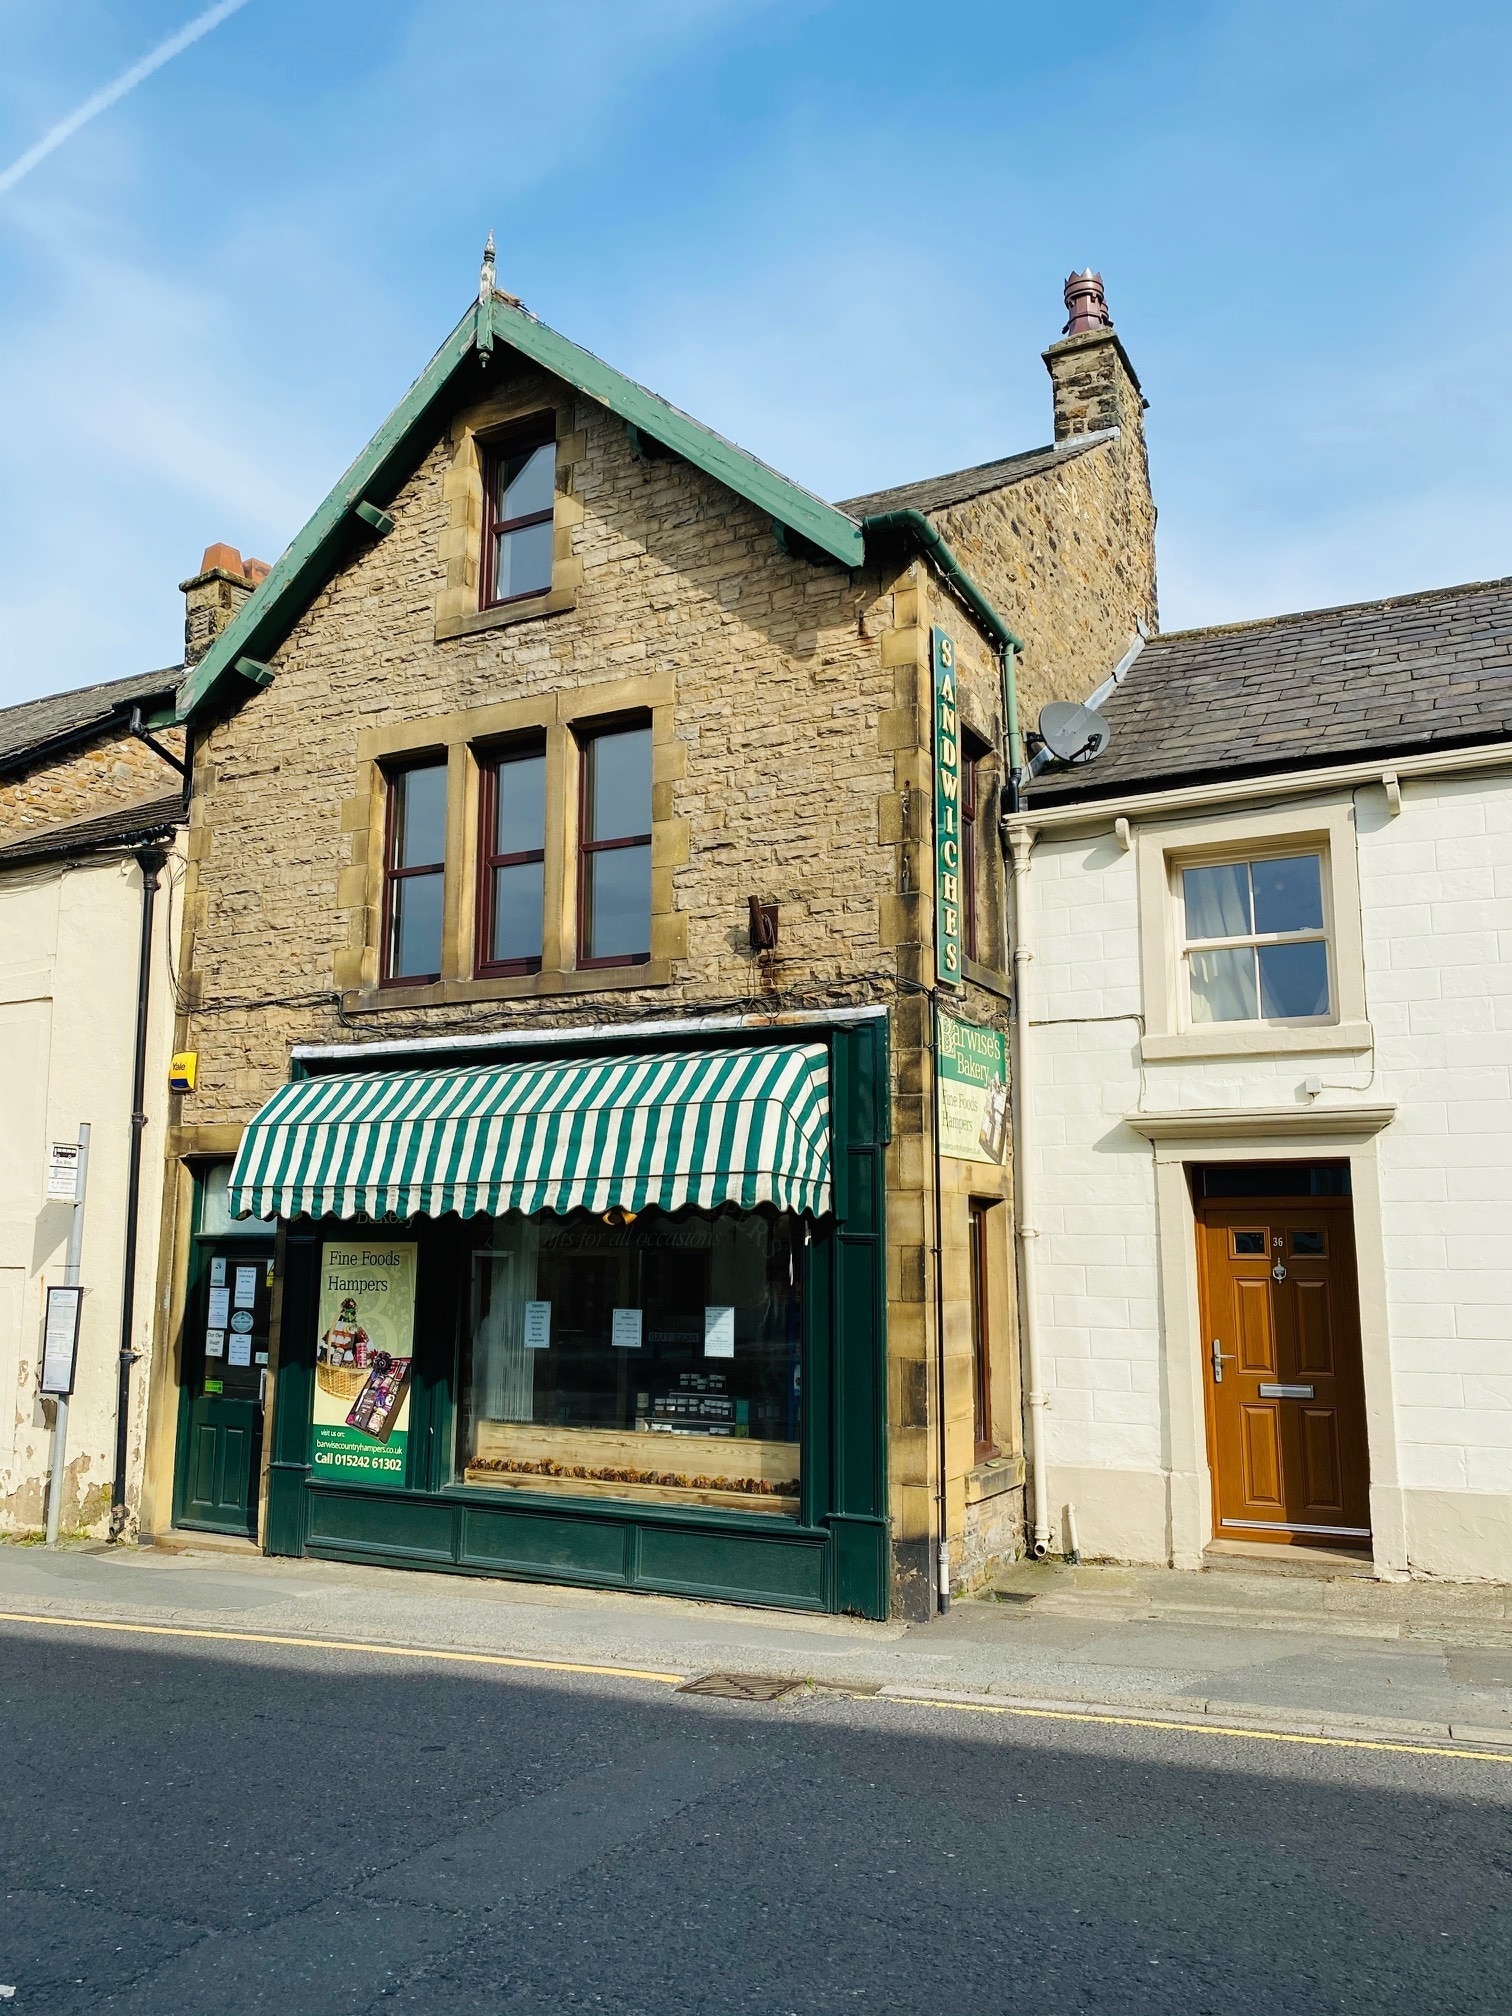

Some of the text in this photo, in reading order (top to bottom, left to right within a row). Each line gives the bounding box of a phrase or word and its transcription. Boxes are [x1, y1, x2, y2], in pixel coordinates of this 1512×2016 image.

[940, 639, 958, 972] SANDWICHES
[940, 1014, 1001, 1060] Barwise's
[173, 1062, 186, 1071] Yale
[957, 1051, 990, 1087] Bakery
[958, 1093, 978, 1112] Foods
[942, 1111, 973, 1134] Hampers
[356, 1211, 415, 1229] Bkey
[574, 1227, 606, 1250] for
[611, 1224, 633, 1248] all
[635, 1226, 722, 1248] occasions
[1272, 1237, 1284, 1247] 36
[329, 1250, 400, 1266] Fine Foods
[328, 1275, 388, 1295] Hampers
[316, 1439, 403, 1455] barwisecountryhampers.co.uk
[315, 1451, 402, 1471] Call 015242 61302
